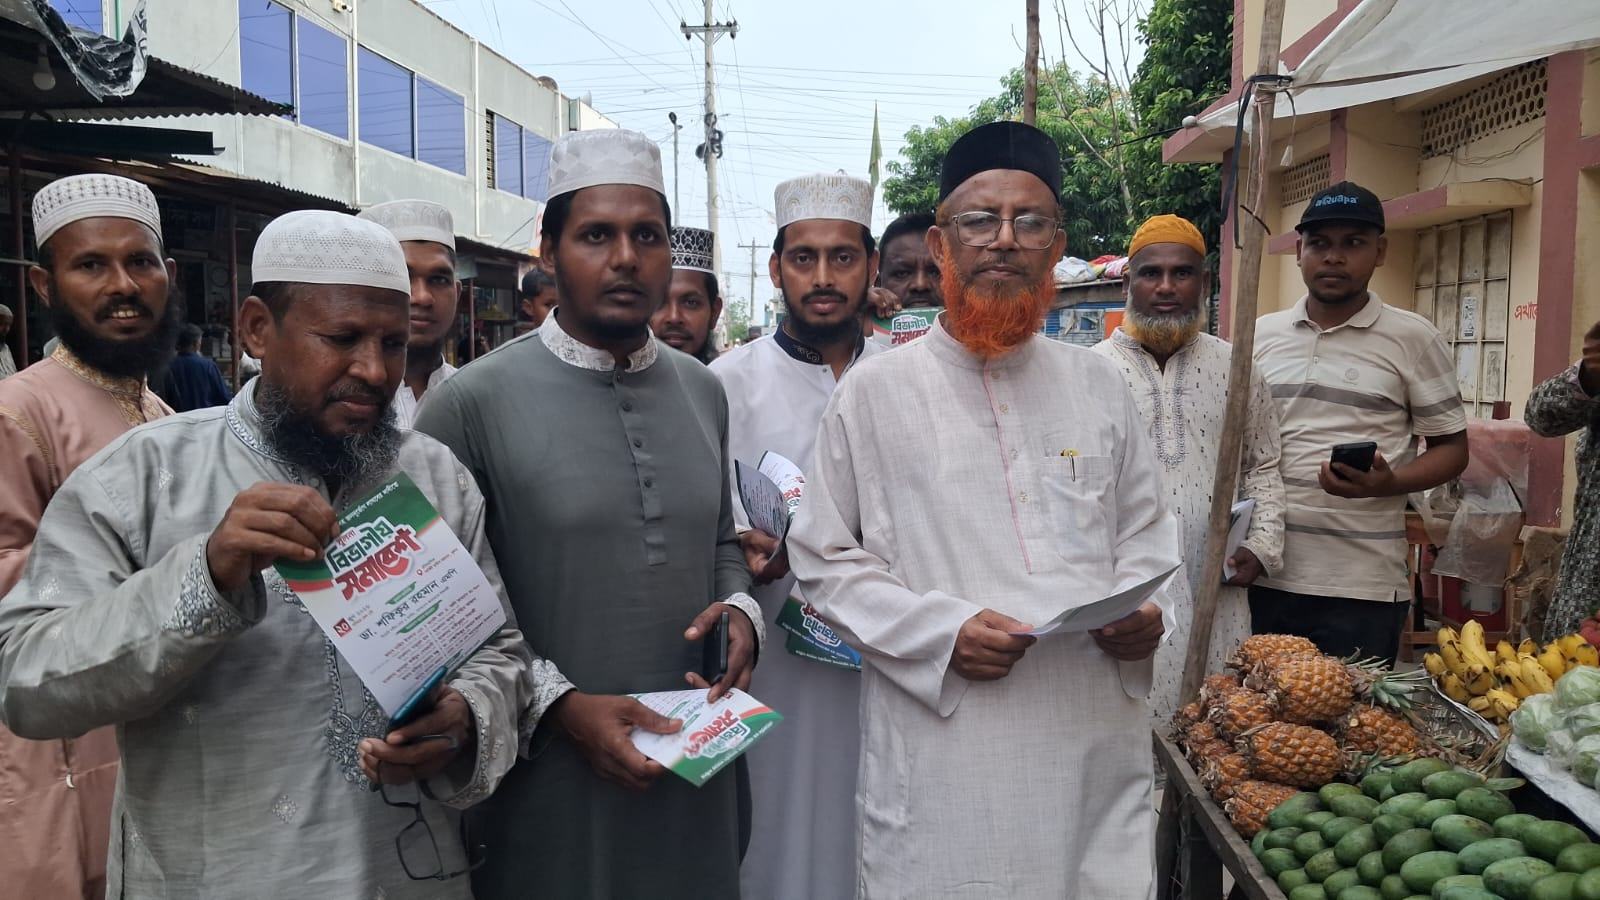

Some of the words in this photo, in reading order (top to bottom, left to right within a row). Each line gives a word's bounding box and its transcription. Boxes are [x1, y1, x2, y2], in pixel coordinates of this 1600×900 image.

[326, 519, 394, 573] বিভাগীয়
[335, 528, 421, 601] সমাবেশ
[411, 580, 440, 604] রহমান
